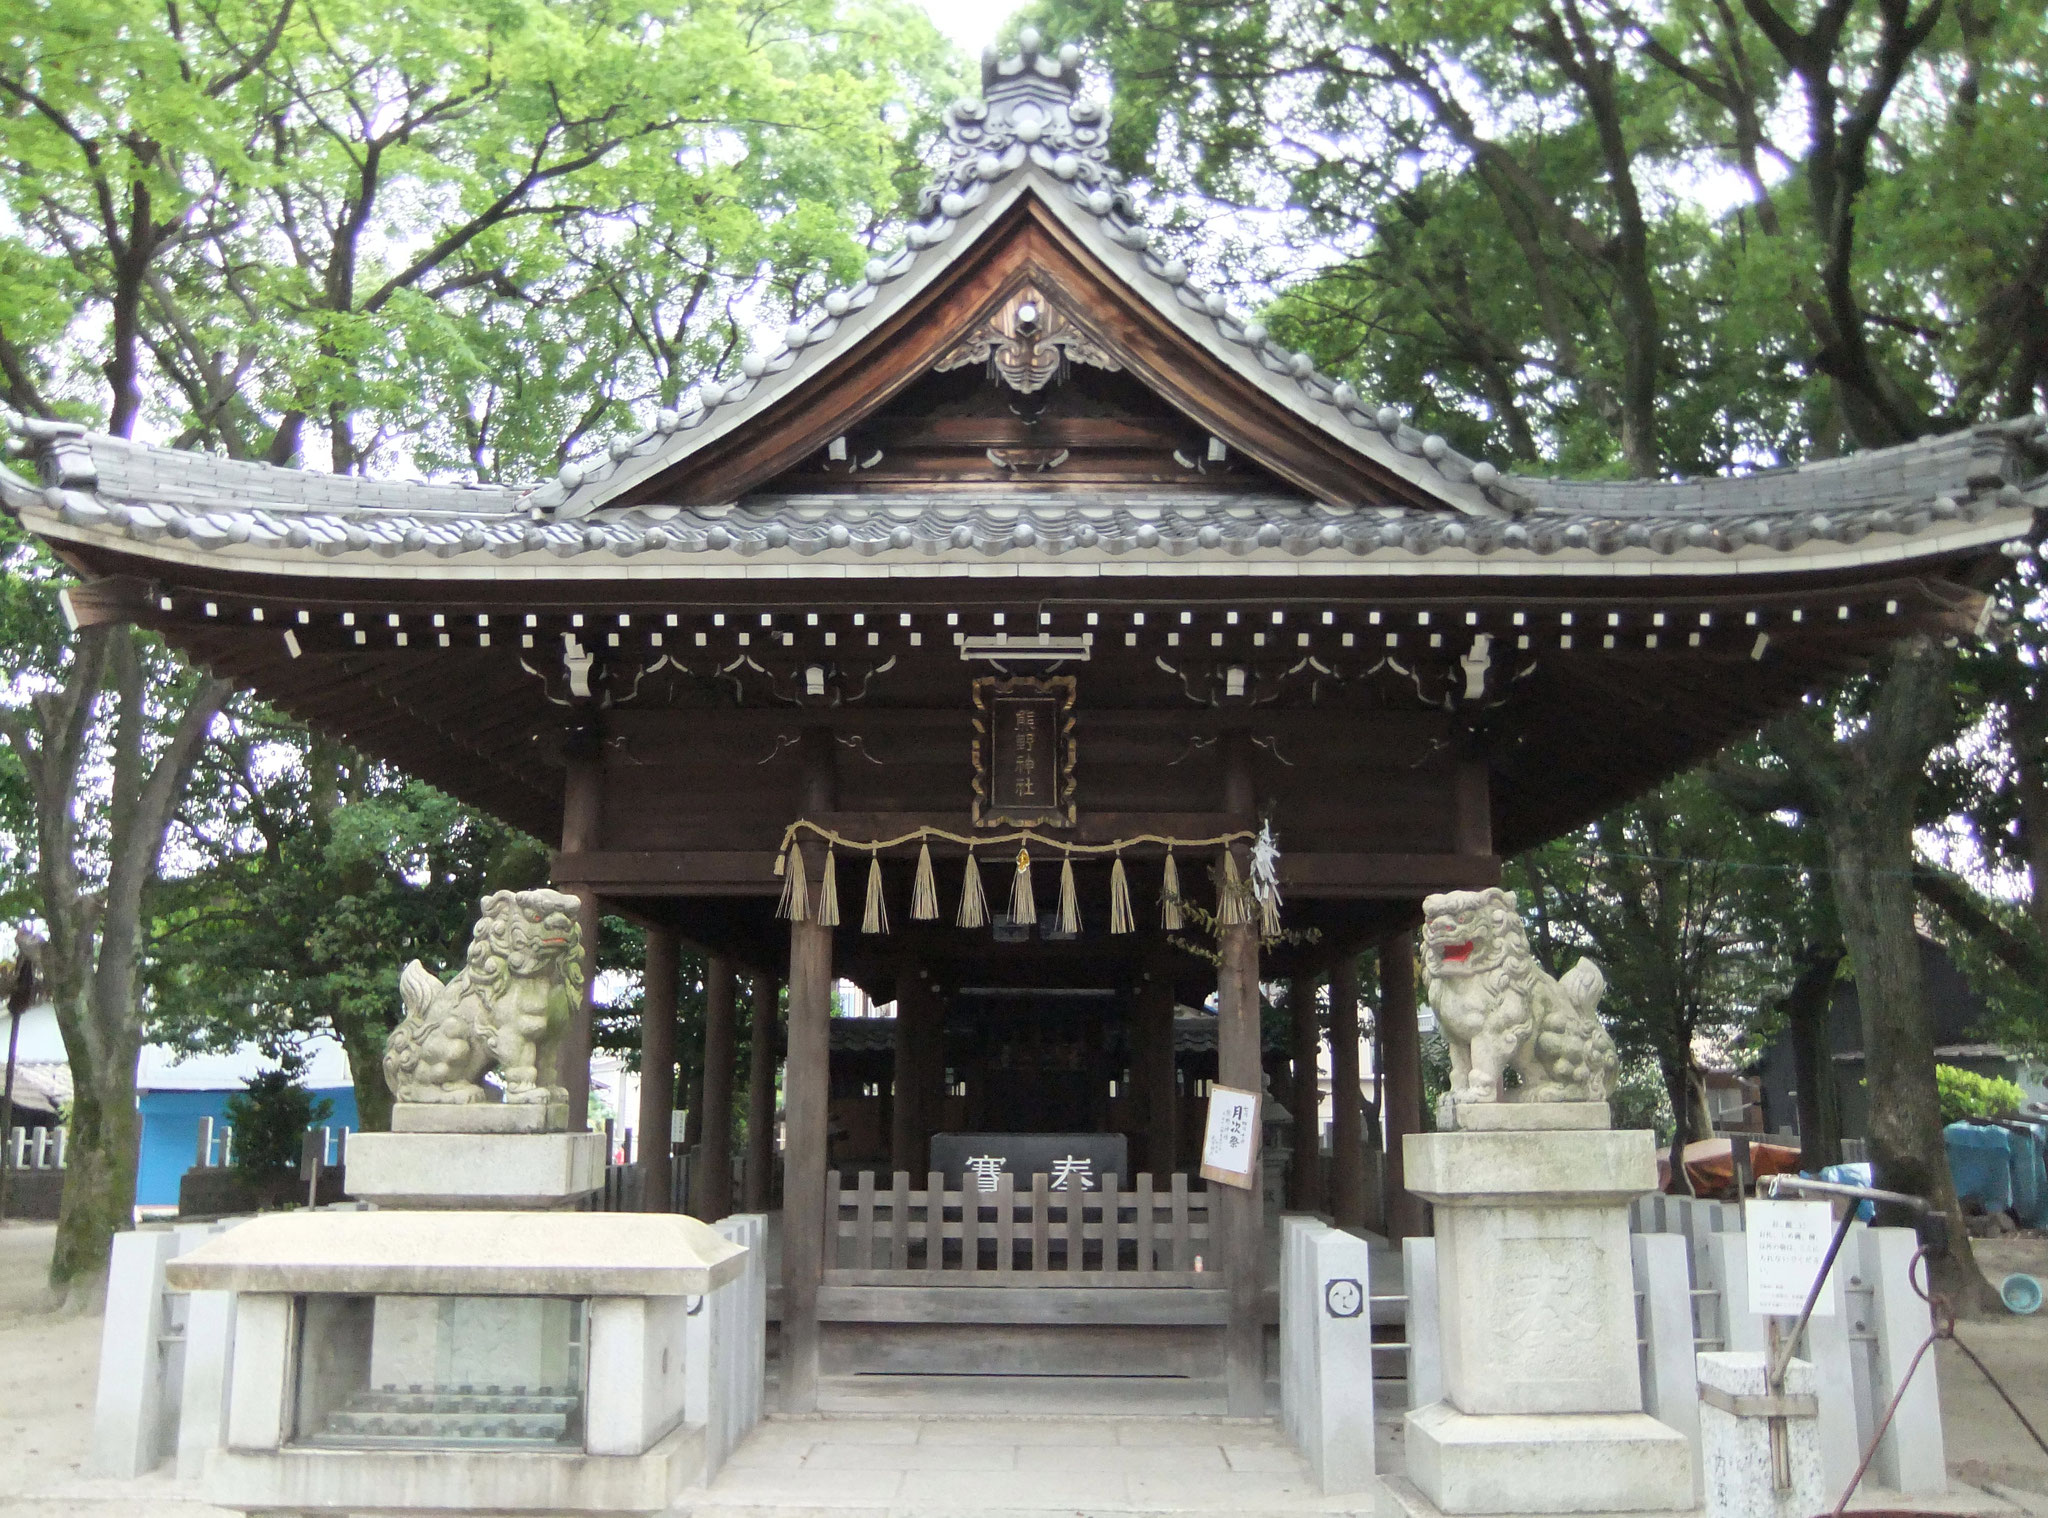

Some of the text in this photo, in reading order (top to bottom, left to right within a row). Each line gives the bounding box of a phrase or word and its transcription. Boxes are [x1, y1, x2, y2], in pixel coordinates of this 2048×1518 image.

[1014, 709, 1035, 797] 熊野神社
[1229, 1105, 1243, 1148] 月次祭
[1051, 1154, 1094, 1191] 奉
